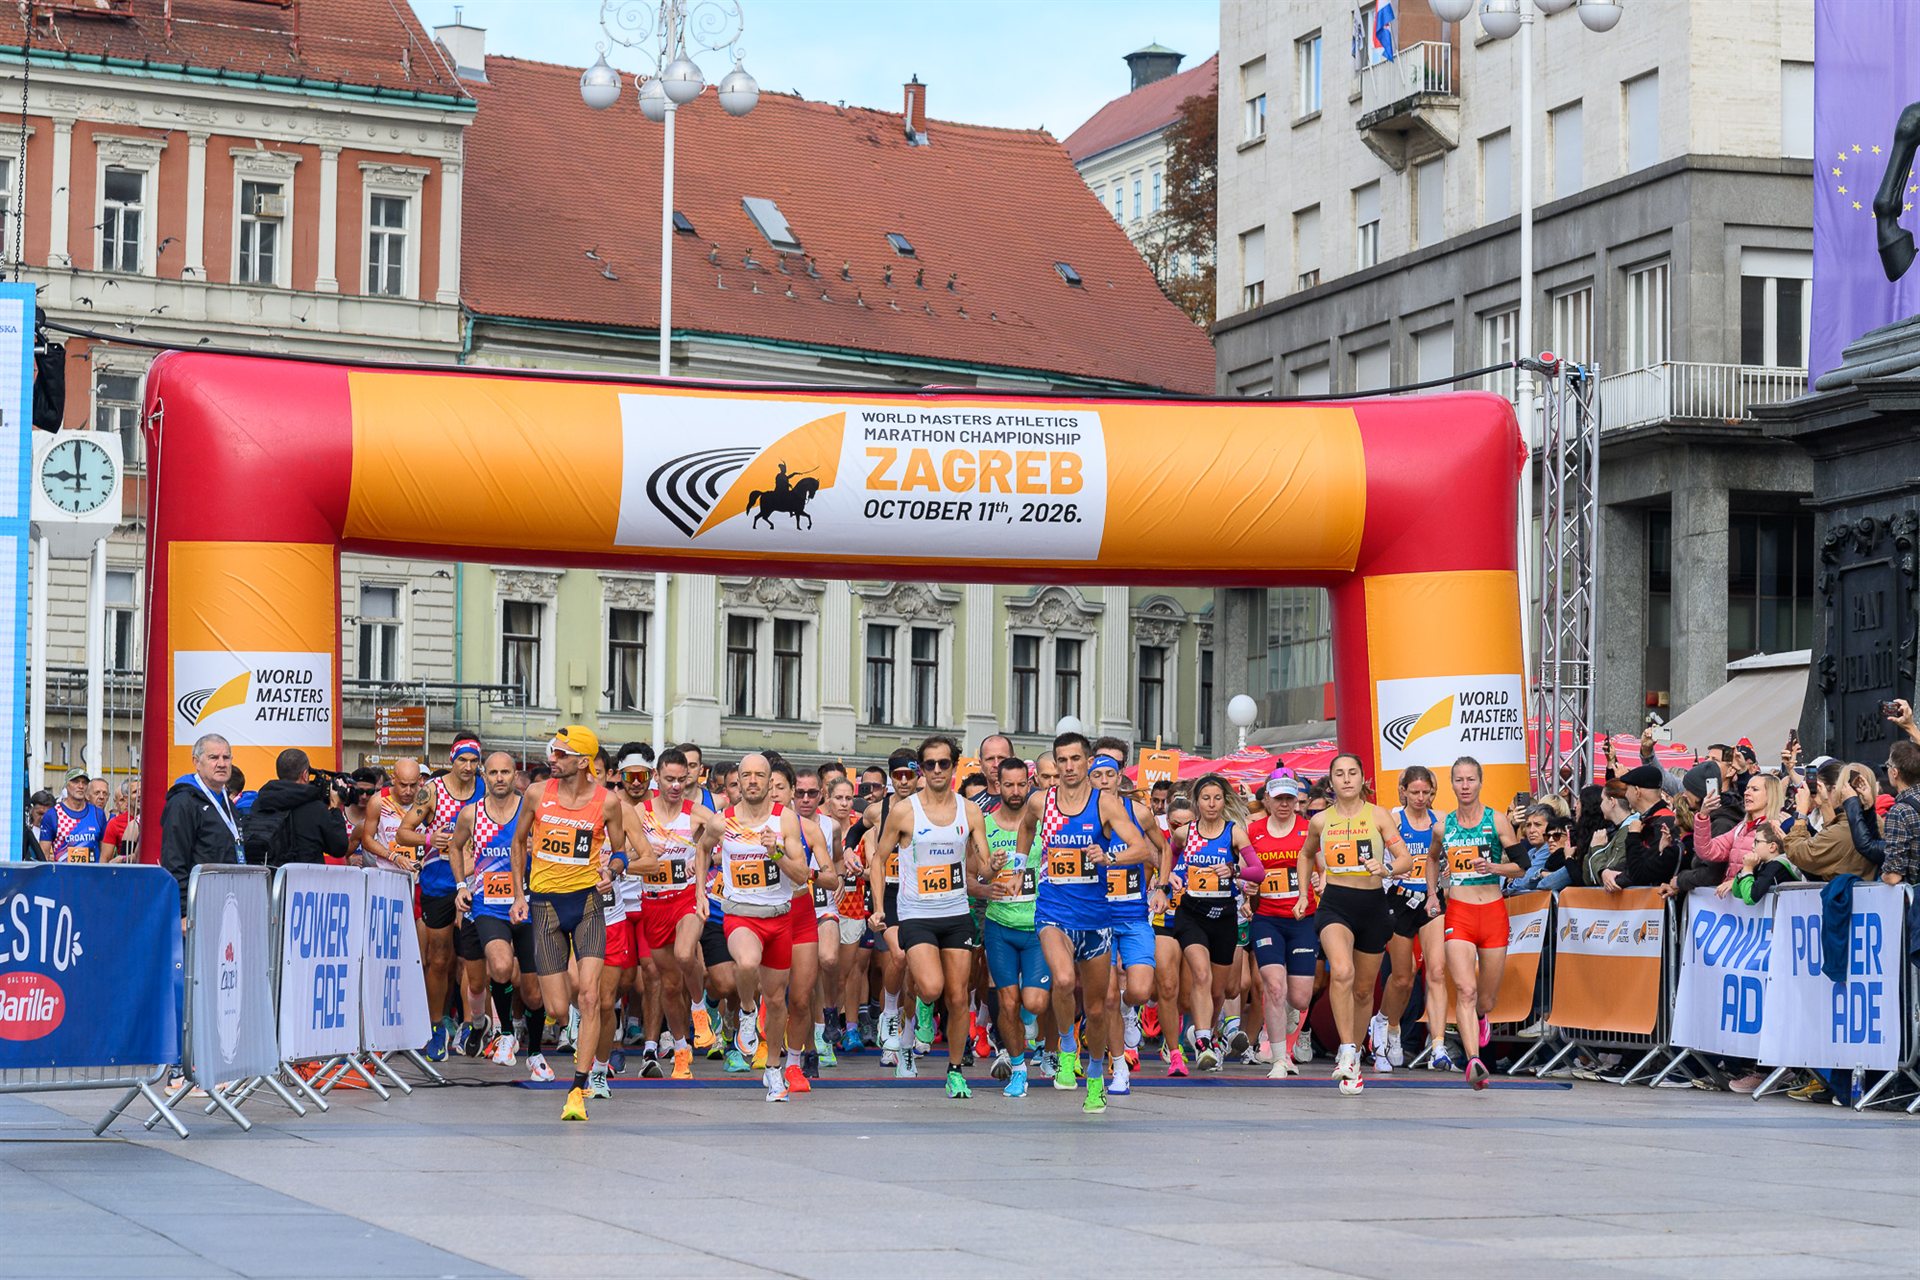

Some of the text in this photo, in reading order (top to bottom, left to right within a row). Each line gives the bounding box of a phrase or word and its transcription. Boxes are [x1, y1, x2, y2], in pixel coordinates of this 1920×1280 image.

[862, 412, 1079, 428] WORLD MASTERS ATHLETICS
[864, 428, 1081, 445] MARATHON CHAMPIONSHIP
[865, 447, 1084, 495] ZAGREB
[863, 498, 1083, 524] OCTOBER 11th, 2026.
[256, 669, 313, 684] WORLD
[255, 688, 324, 703] MASTERS
[1459, 690, 1509, 706] WORLD
[254, 706, 330, 722] ATHLETICS
[1460, 708, 1518, 724] MASTERS
[1460, 726, 1524, 742] ATHLETICS
[1144, 769, 1171, 781] W/M
[541, 814, 595, 831] ESPAÑA
[65, 833, 96, 843] CROATIA
[579, 836, 588, 844] M
[1050, 834, 1094, 845] CROATIA
[1453, 836, 1488, 847] BULGARIA
[482, 847, 512, 857] CROAT
[541, 838, 571, 854] 205
[576, 843, 589, 852] 40
[1360, 845, 1369, 853] W
[70, 855, 87, 863] 376
[1188, 854, 1226, 865] CROATIA
[1256, 850, 1297, 861] ROMANI
[1336, 853, 1346, 865] 8
[675, 864, 682, 872] M
[768, 865, 776, 873] M
[953, 868, 960, 876] M
[1051, 861, 1075, 875] 163
[735, 872, 760, 886] 158
[1024, 874, 1032, 882] M
[1129, 873, 1137, 881] W
[1198, 878, 1207, 889] 2
[487, 883, 512, 895] 245
[922, 877, 947, 891] 148
[1023, 881, 1034, 889] 35
[1267, 880, 1279, 891] 11
[290, 891, 350, 959] POWER
[1693, 909, 1773, 972] POWE
[1791, 912, 1883, 977] POER
[312, 964, 348, 1030] ADE
[1720, 973, 1767, 1035] AD
[1831, 982, 1884, 1045] ADE
